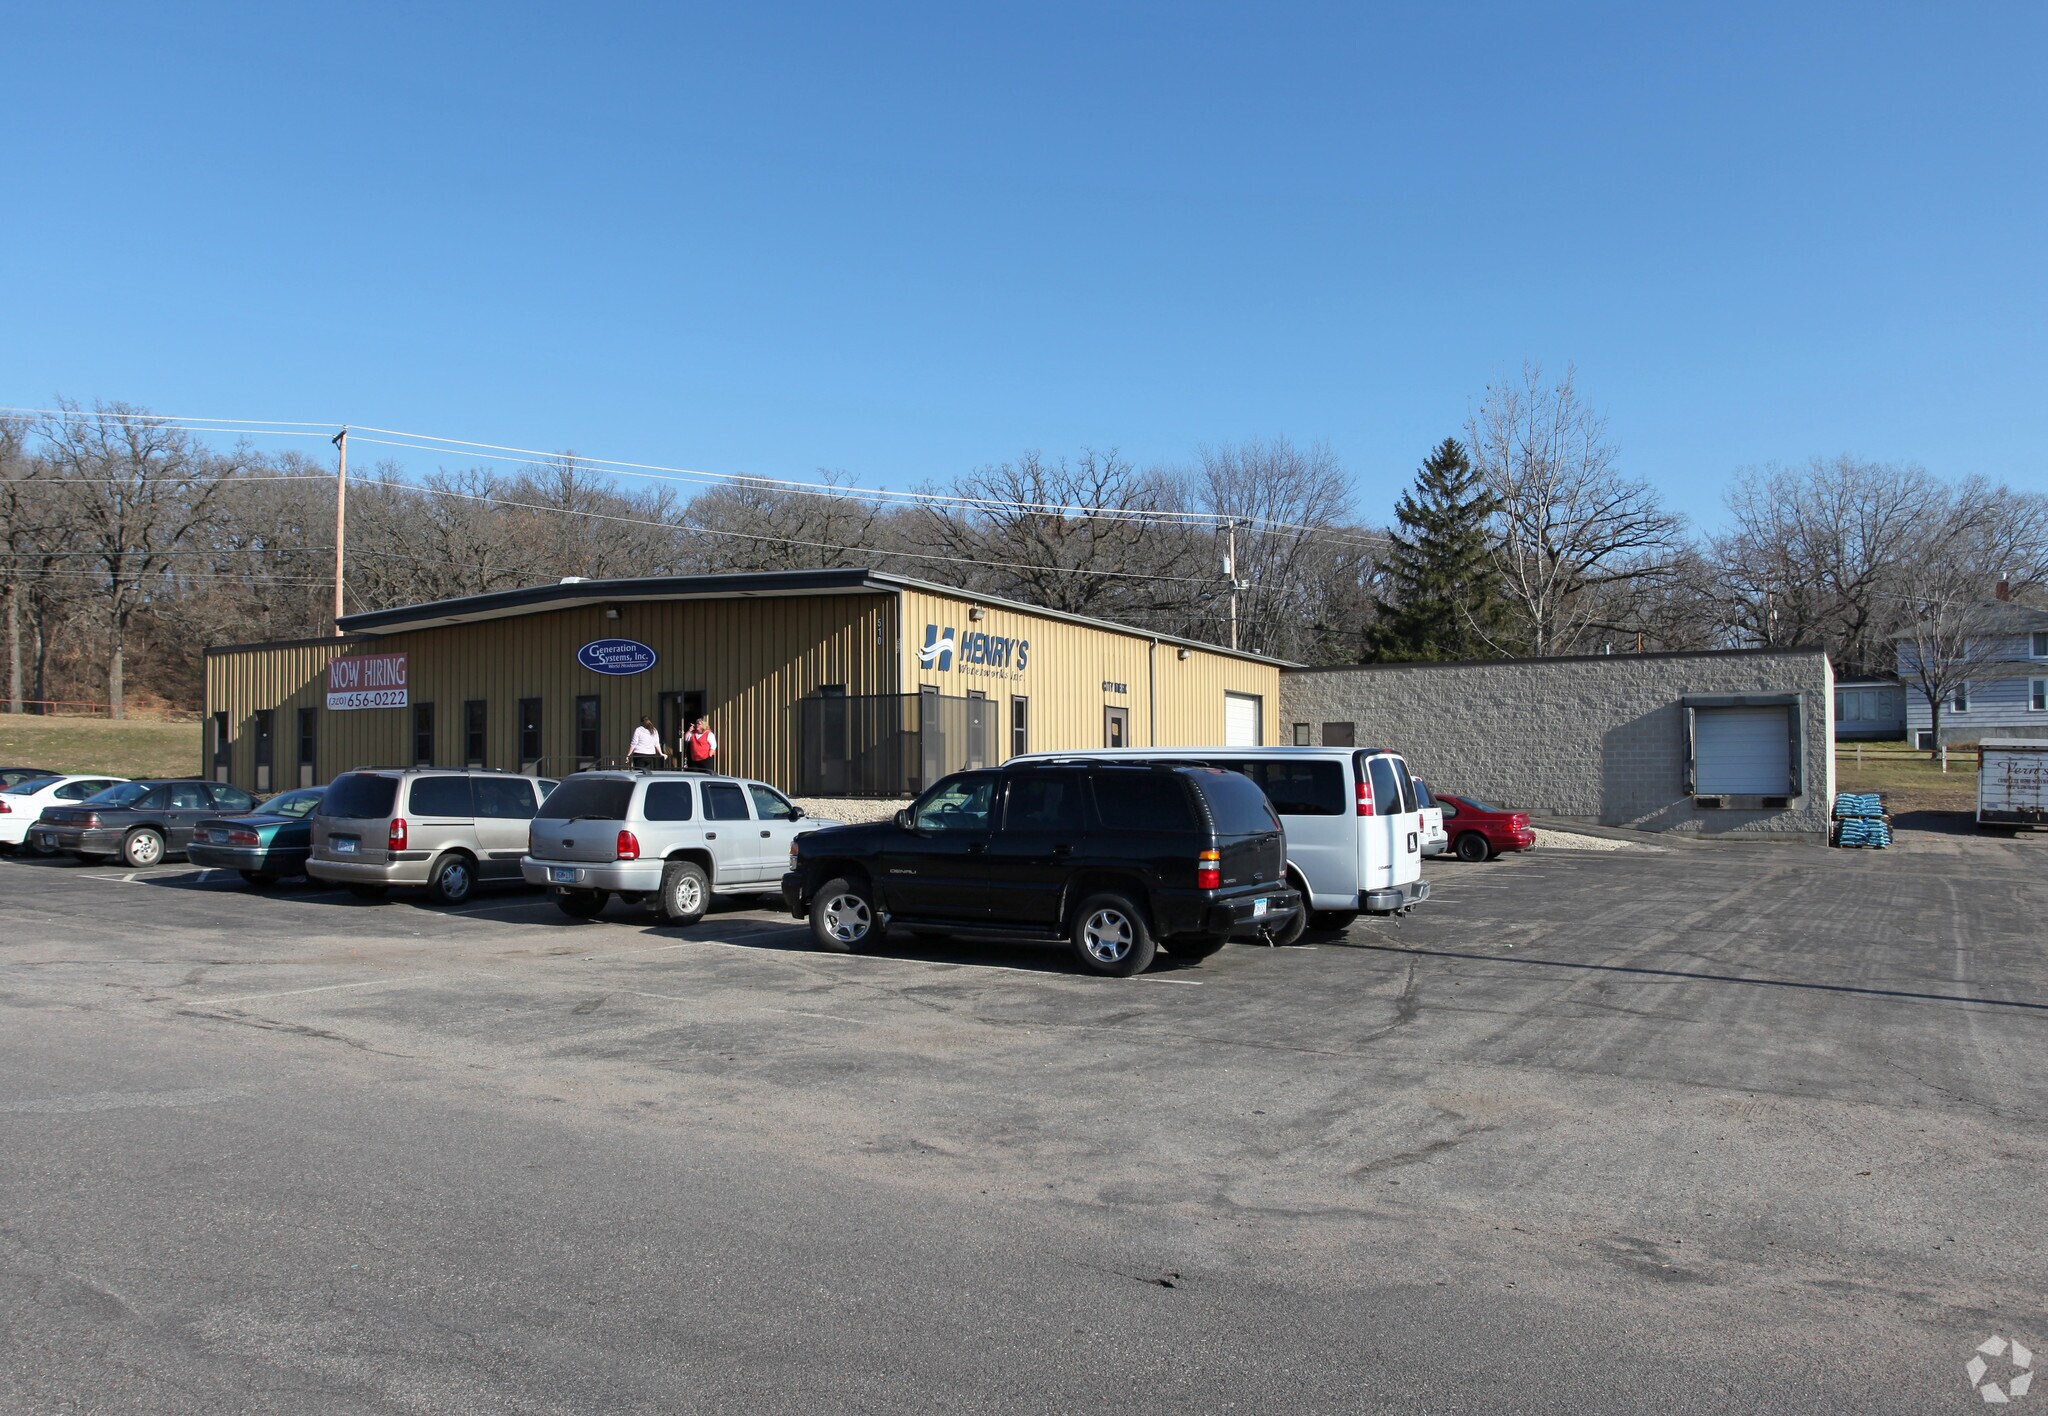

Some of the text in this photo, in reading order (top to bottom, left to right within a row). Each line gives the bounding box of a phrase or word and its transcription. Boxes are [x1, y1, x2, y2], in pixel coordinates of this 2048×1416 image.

[589, 644, 637, 657] Generation
[598, 652, 649, 665] Systems, Inc.
[959, 630, 1029, 671] HENRY'S
[330, 657, 406, 689] NOW HIRING
[328, 691, 406, 707] (320) 656-0222
